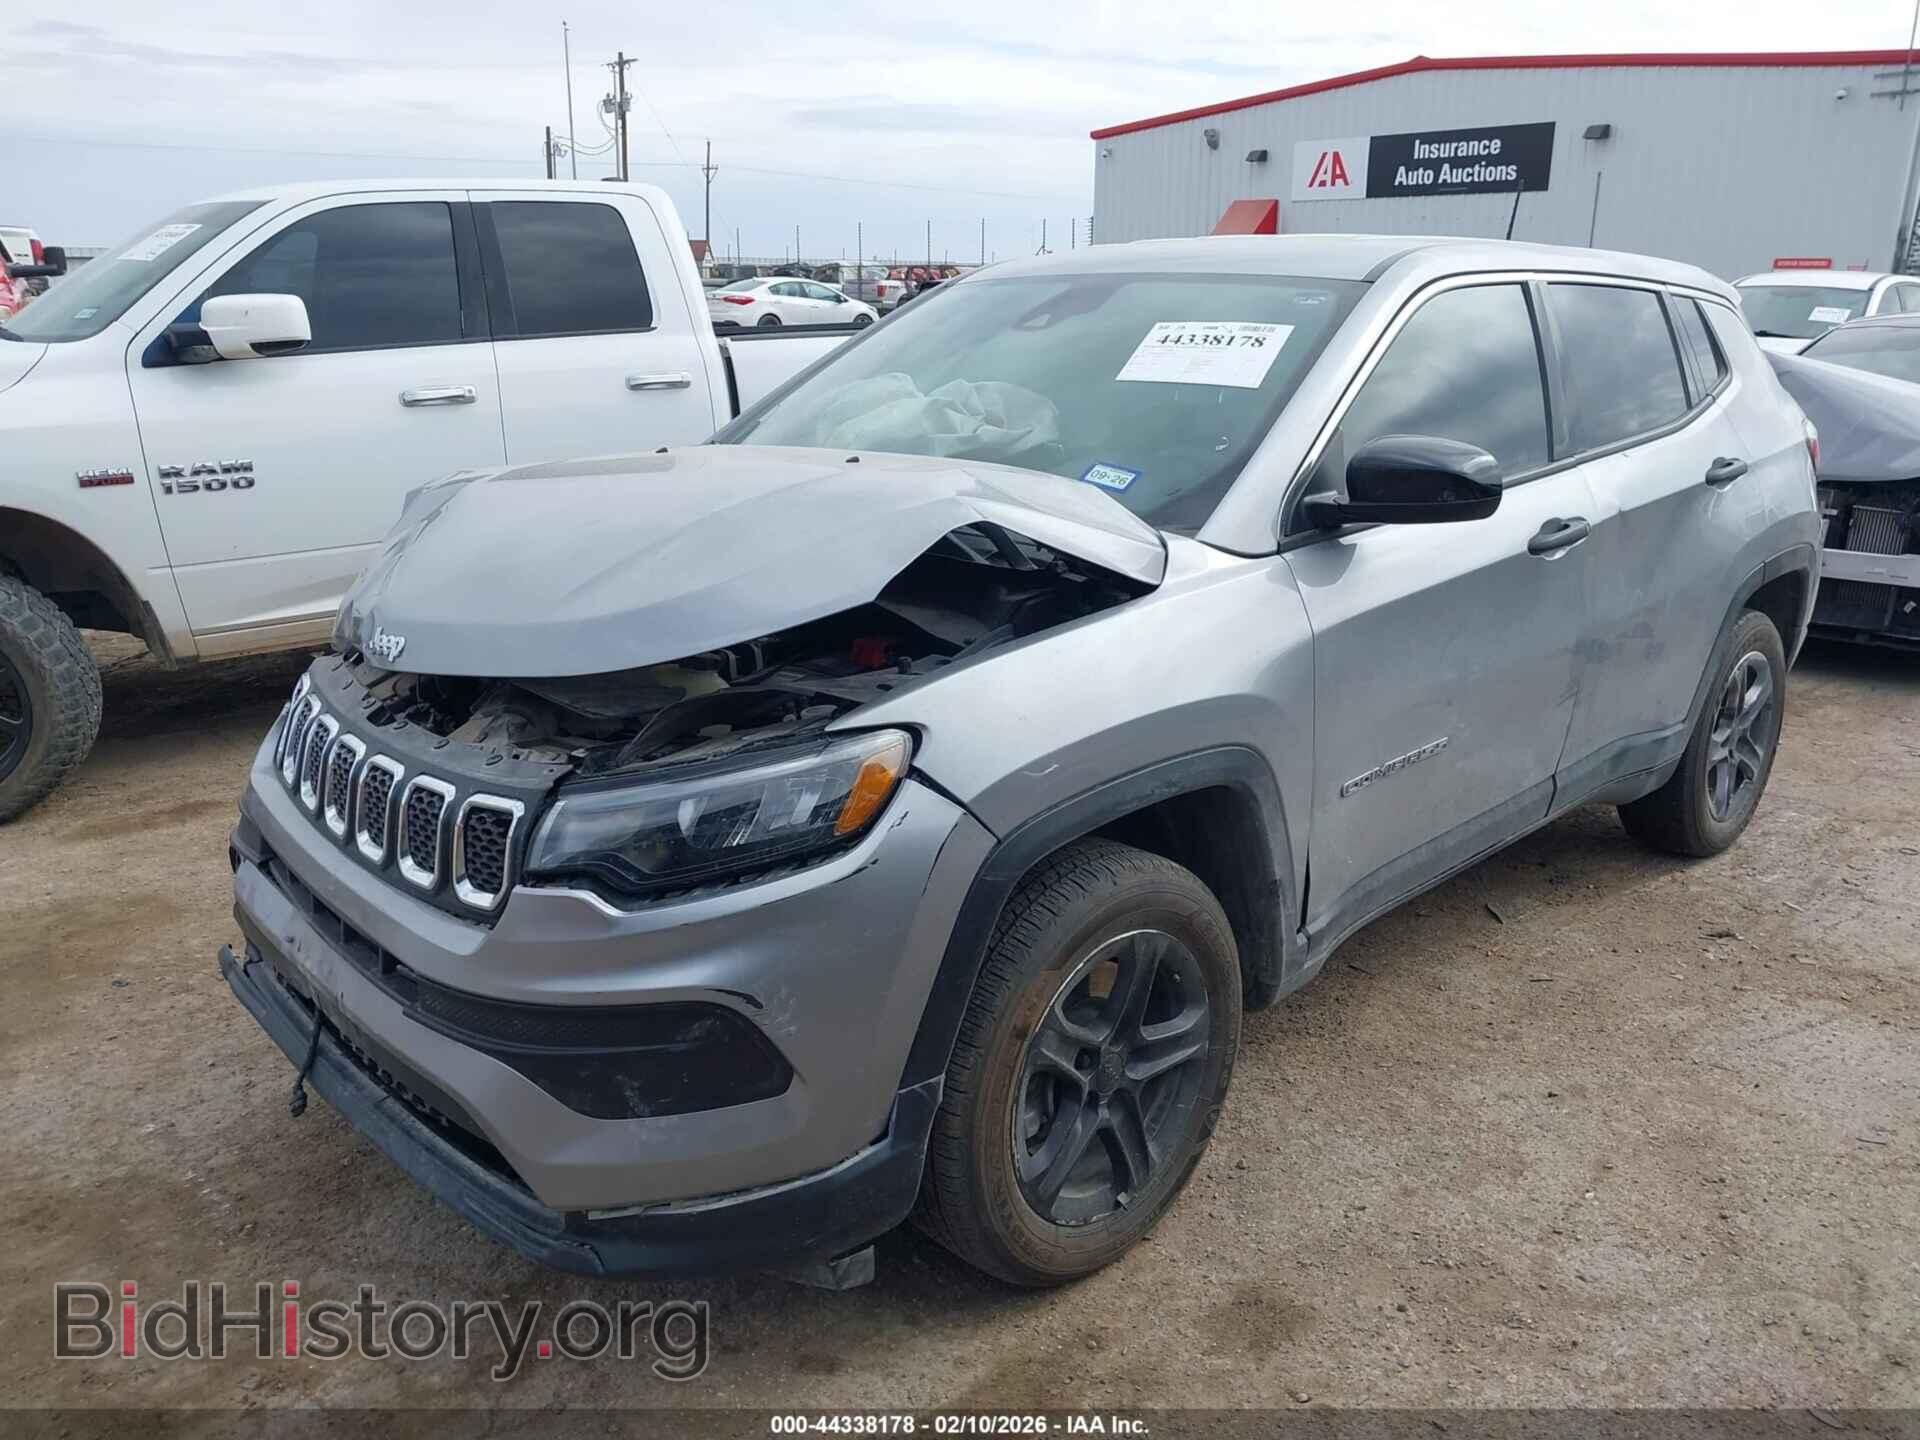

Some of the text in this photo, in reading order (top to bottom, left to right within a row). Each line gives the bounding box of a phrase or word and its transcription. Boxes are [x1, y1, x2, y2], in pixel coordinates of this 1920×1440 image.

[1413, 138, 1501, 159] Insurance
[1393, 161, 1518, 186] Auto Auctions
[1155, 333, 1267, 349] 44338178
[158, 459, 254, 479] RAM
[160, 475, 256, 495] 1500
[369, 623, 406, 662] Jeep
